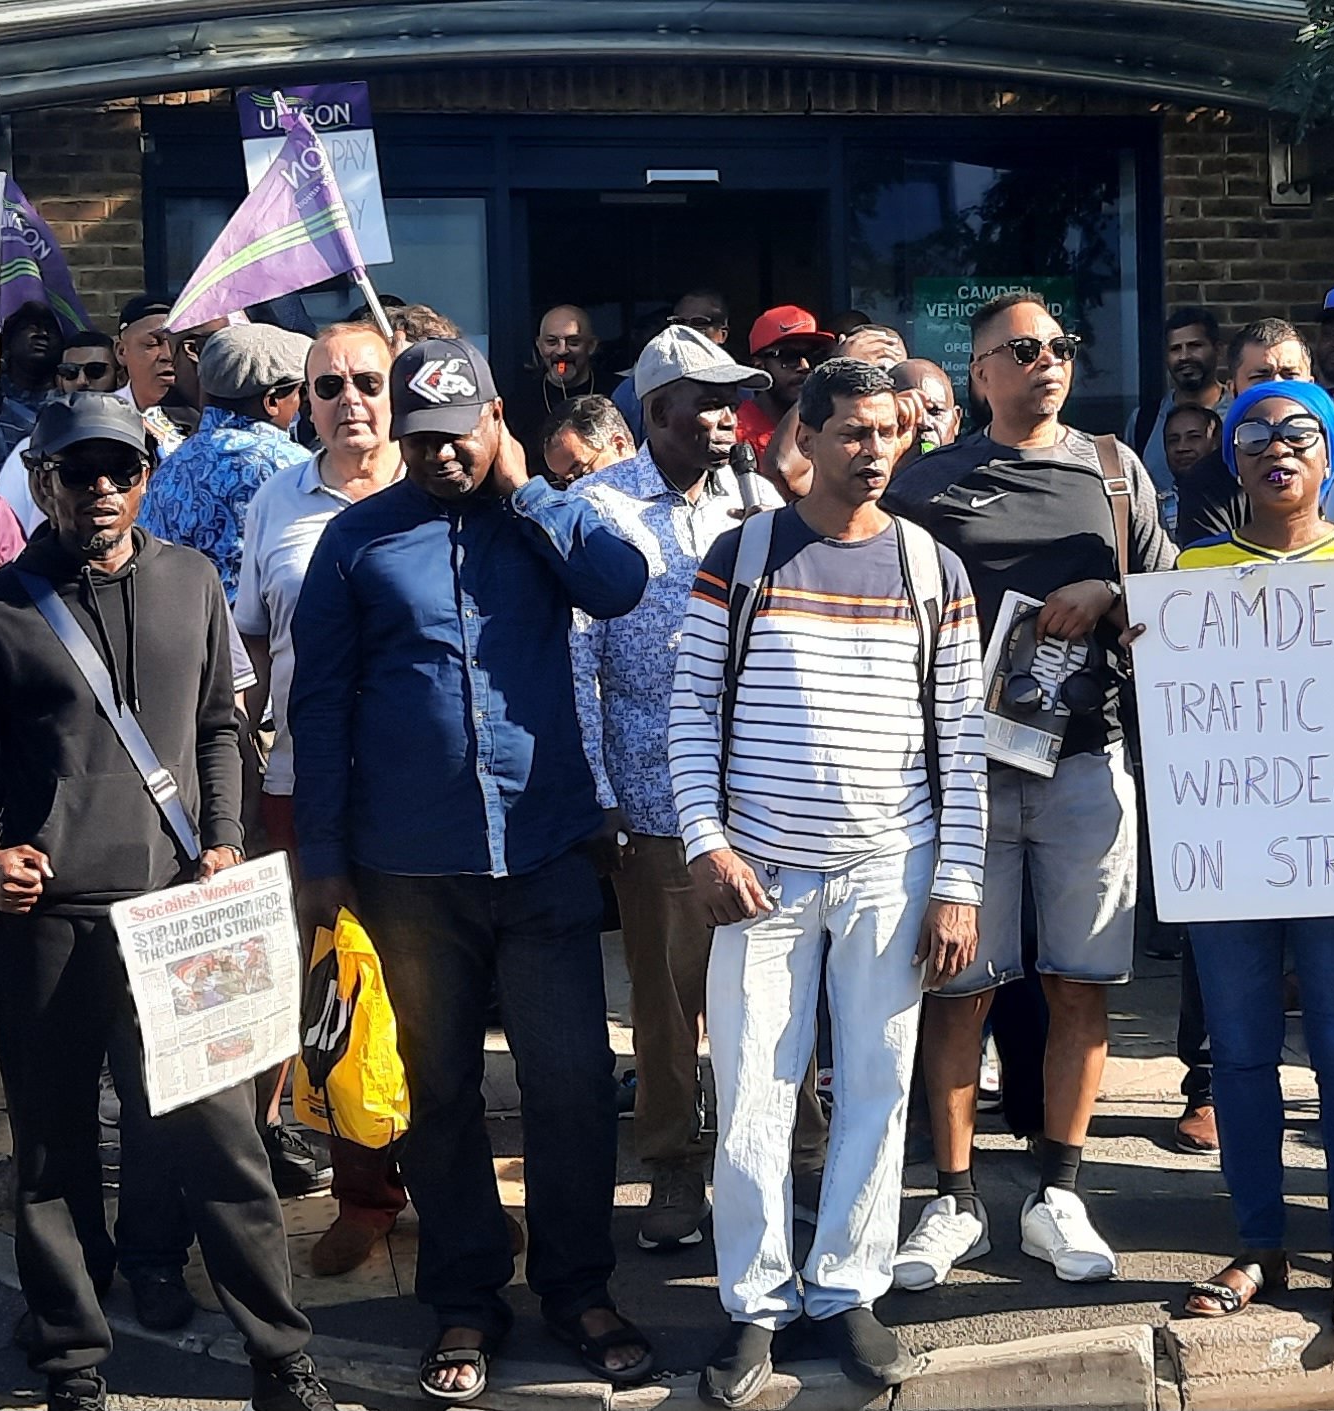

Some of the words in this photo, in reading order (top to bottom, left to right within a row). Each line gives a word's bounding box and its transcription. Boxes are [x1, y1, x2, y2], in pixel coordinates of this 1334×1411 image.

[926, 302, 984, 318] VEHIC
[1155, 678, 1324, 735] TRAFFIC
[1171, 841, 1223, 891] ON
